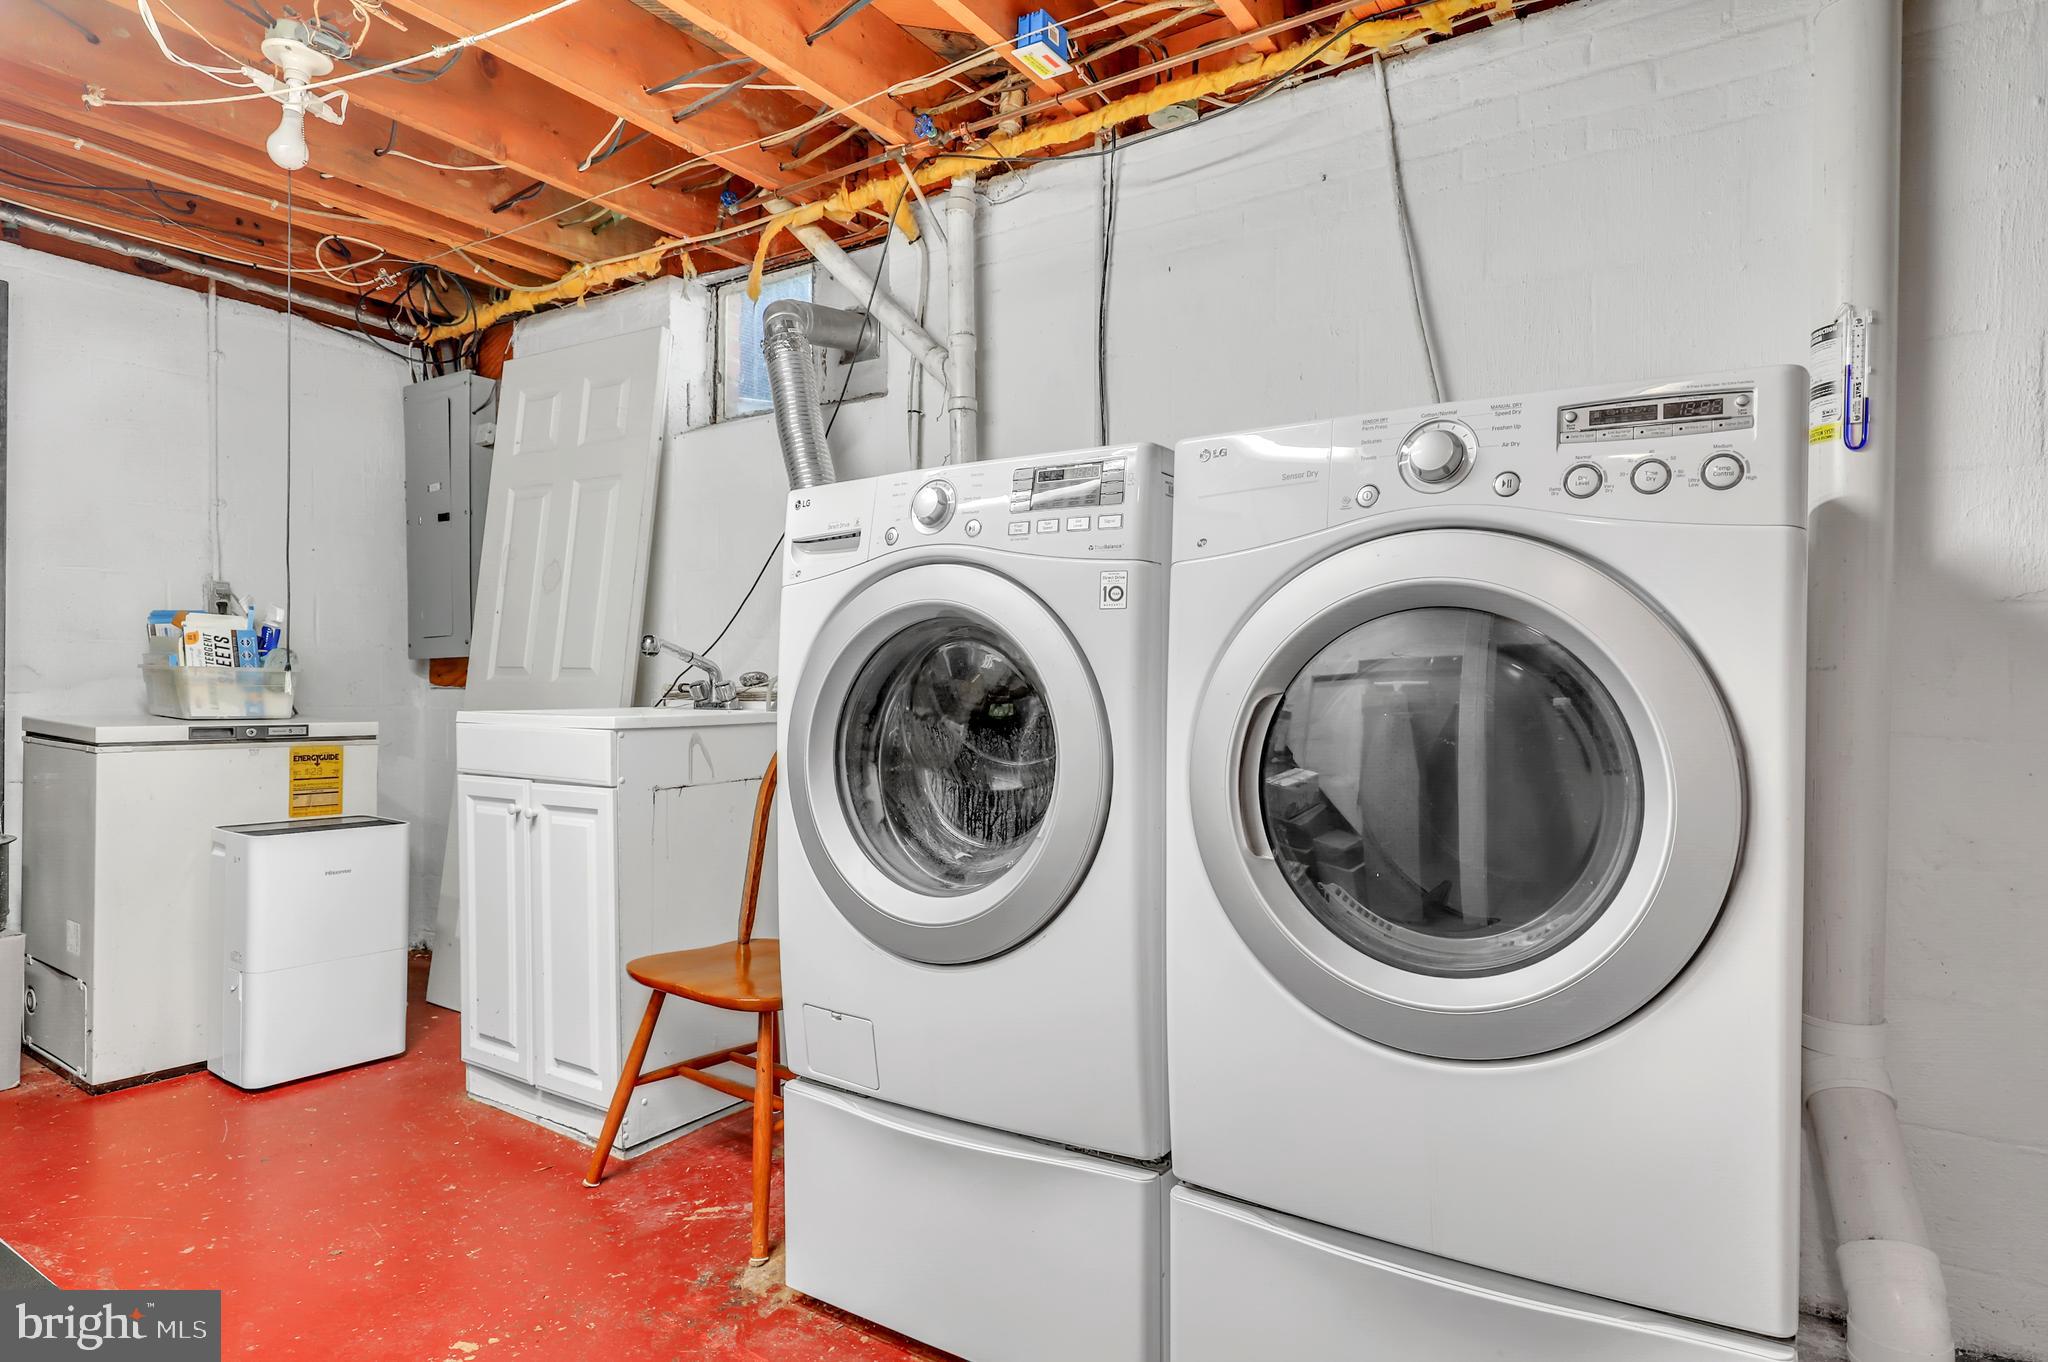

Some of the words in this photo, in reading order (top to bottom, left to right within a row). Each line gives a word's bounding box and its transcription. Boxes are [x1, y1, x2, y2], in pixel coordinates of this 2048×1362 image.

[1421, 410, 1457, 419] Cotton/Normal
[1281, 472, 1305, 481] Sensor
[1306, 470, 1319, 479] Dry
[1103, 585, 1124, 602] 10
[203, 632, 214, 667] TERGENT
[213, 635, 232, 668] EETS
[293, 753, 339, 763] ENERGYGUIDE
